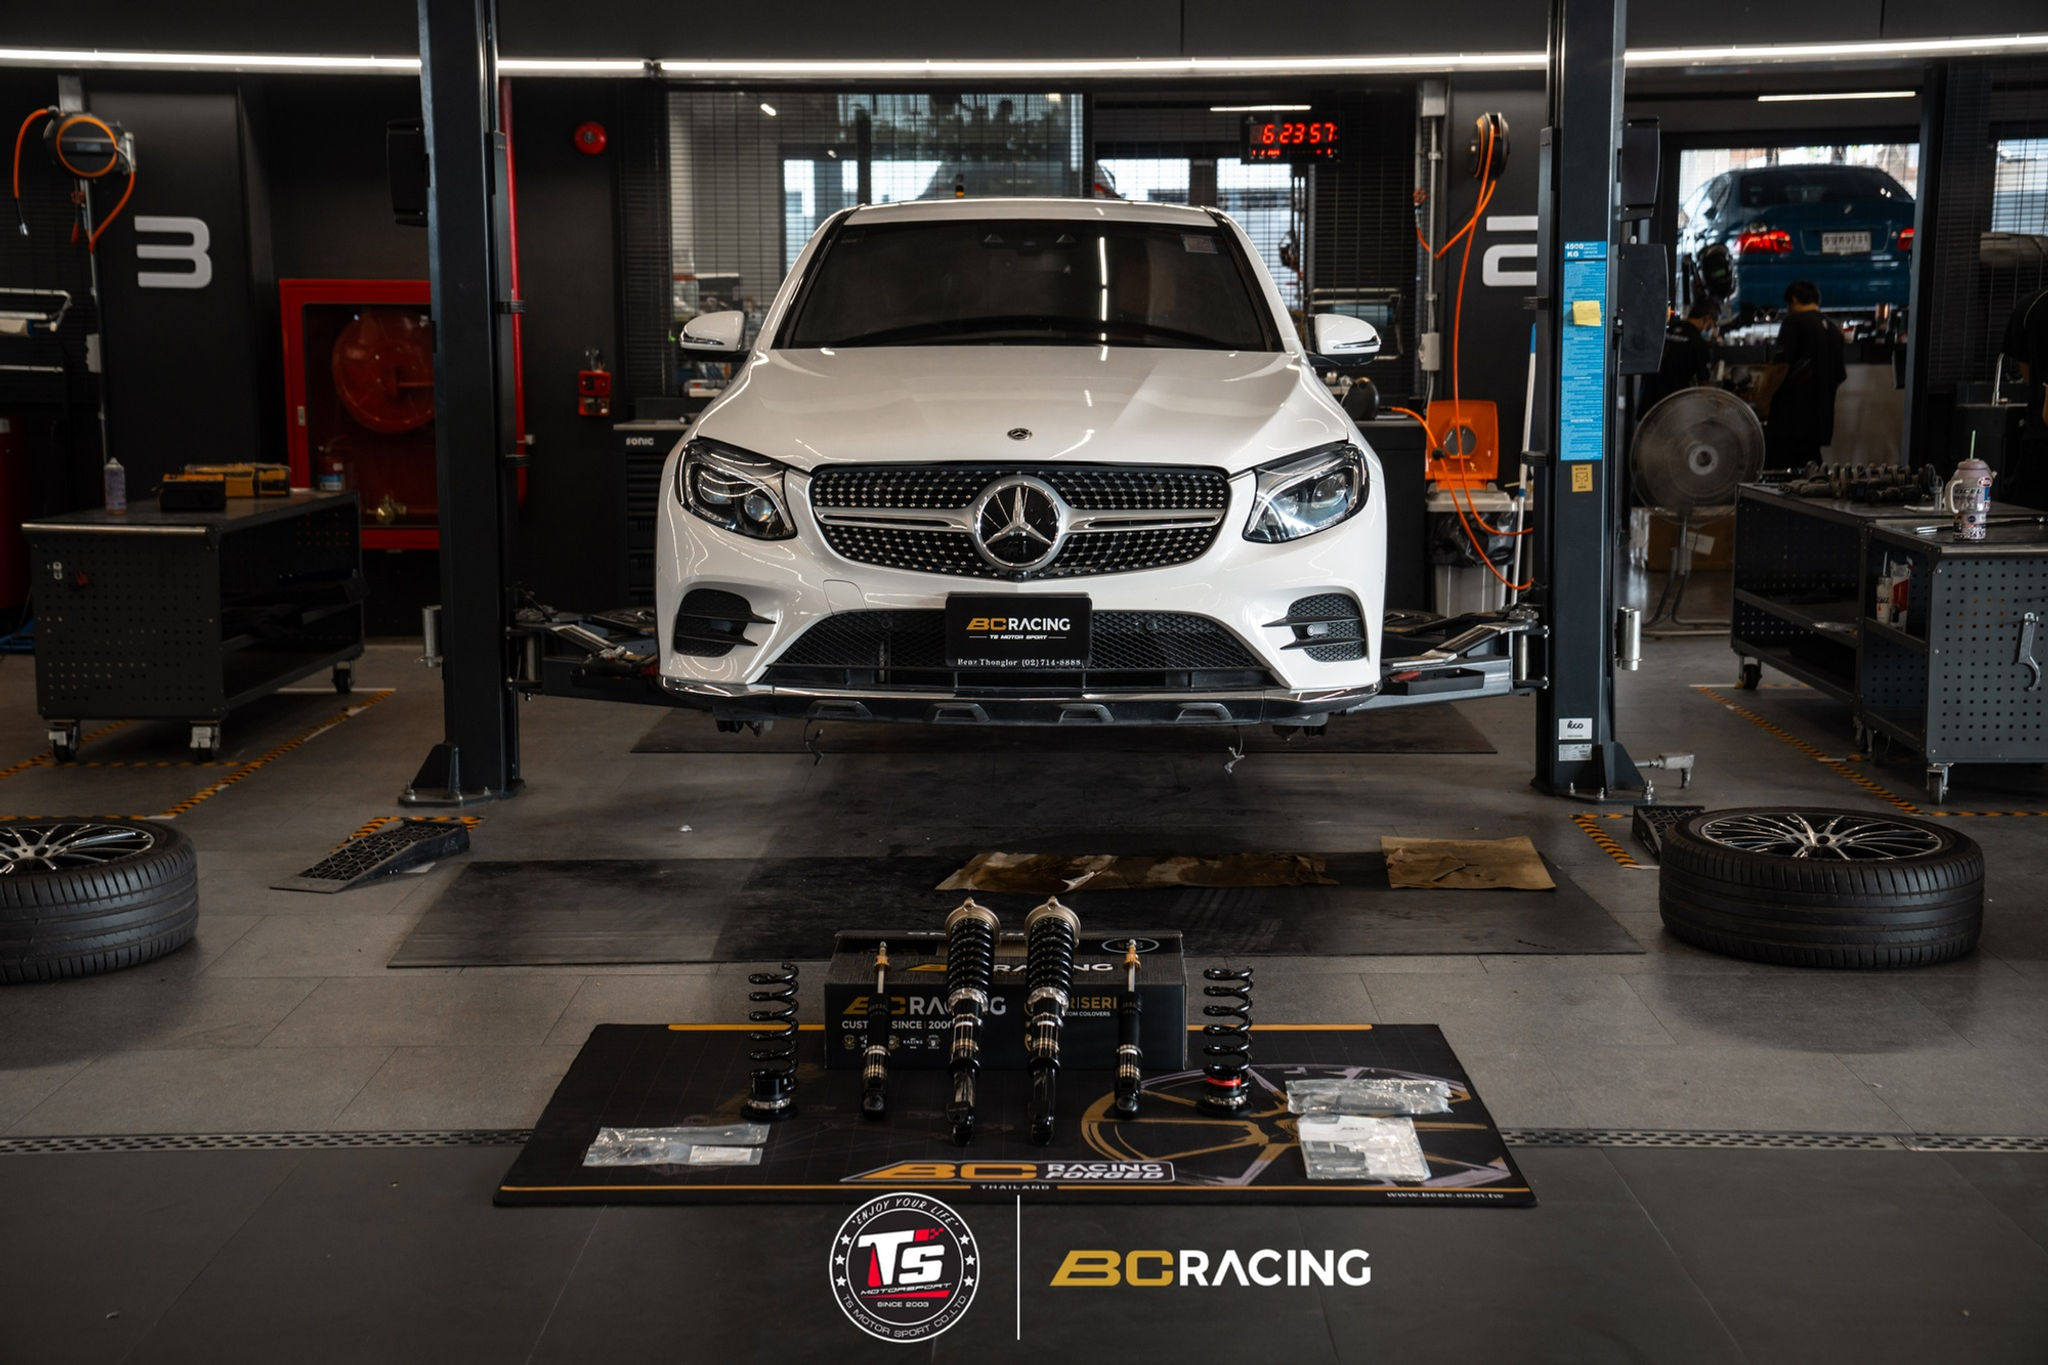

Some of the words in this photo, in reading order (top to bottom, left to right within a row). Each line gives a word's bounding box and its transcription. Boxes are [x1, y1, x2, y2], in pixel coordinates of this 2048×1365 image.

[134, 215, 212, 289] 3
[891, 1020, 922, 1029] SINCE
[861, 1163, 1037, 1180] BC
[1047, 1163, 1162, 1172] RACING
[1045, 1172, 1165, 1180] FORGED
